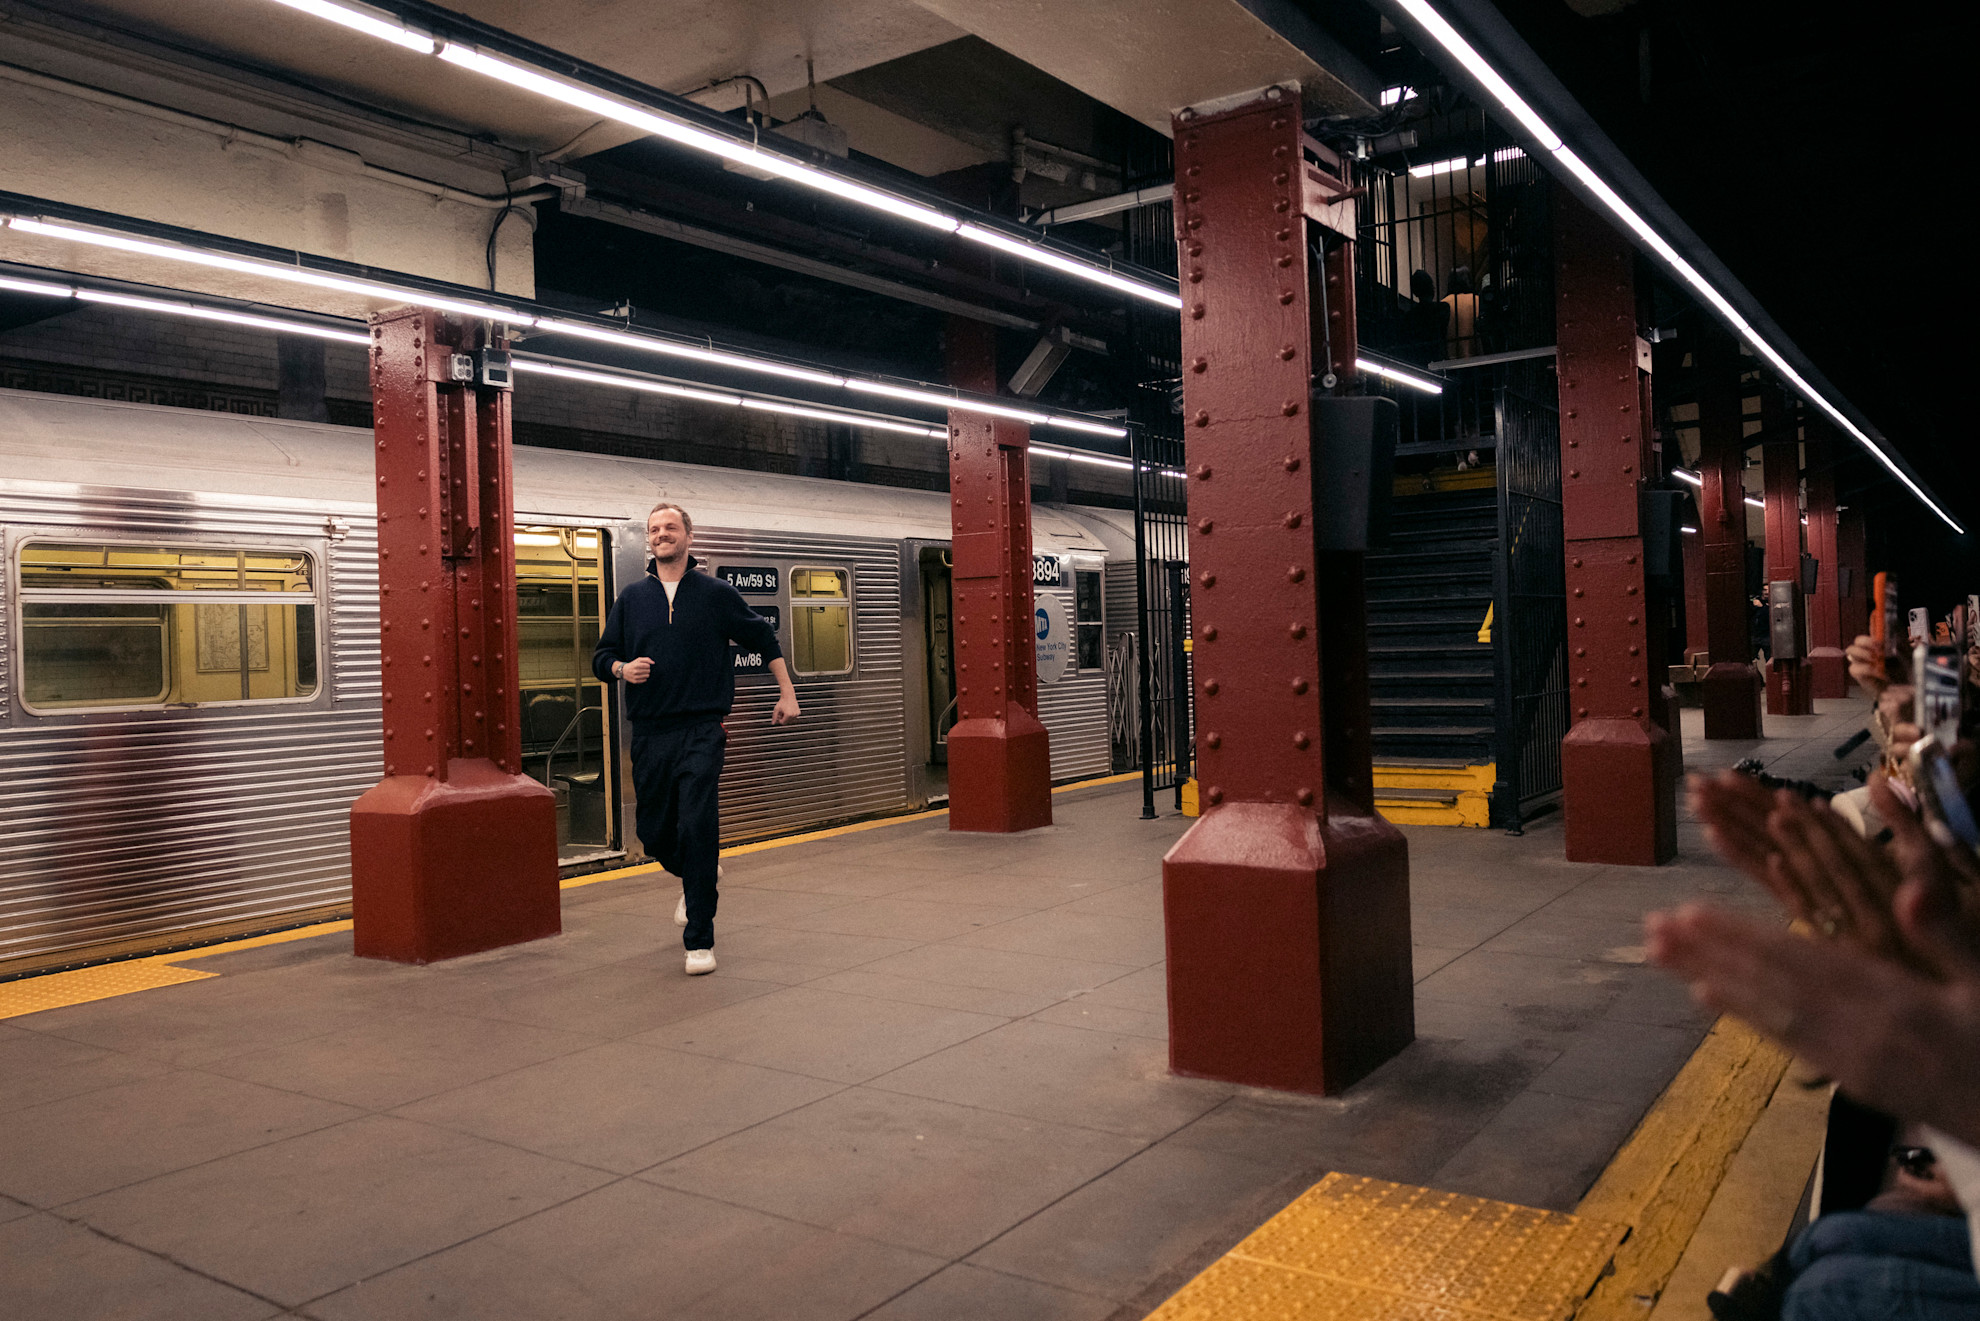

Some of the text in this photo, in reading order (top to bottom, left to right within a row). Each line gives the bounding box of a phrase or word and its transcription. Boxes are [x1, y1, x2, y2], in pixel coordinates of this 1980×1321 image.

[727, 573, 776, 587] 5 Av/59 St
[1047, 643, 1057, 651] York
[1057, 642, 1066, 651] City
[734, 653, 762, 667] Av/86
[1036, 653, 1055, 662] Subway
